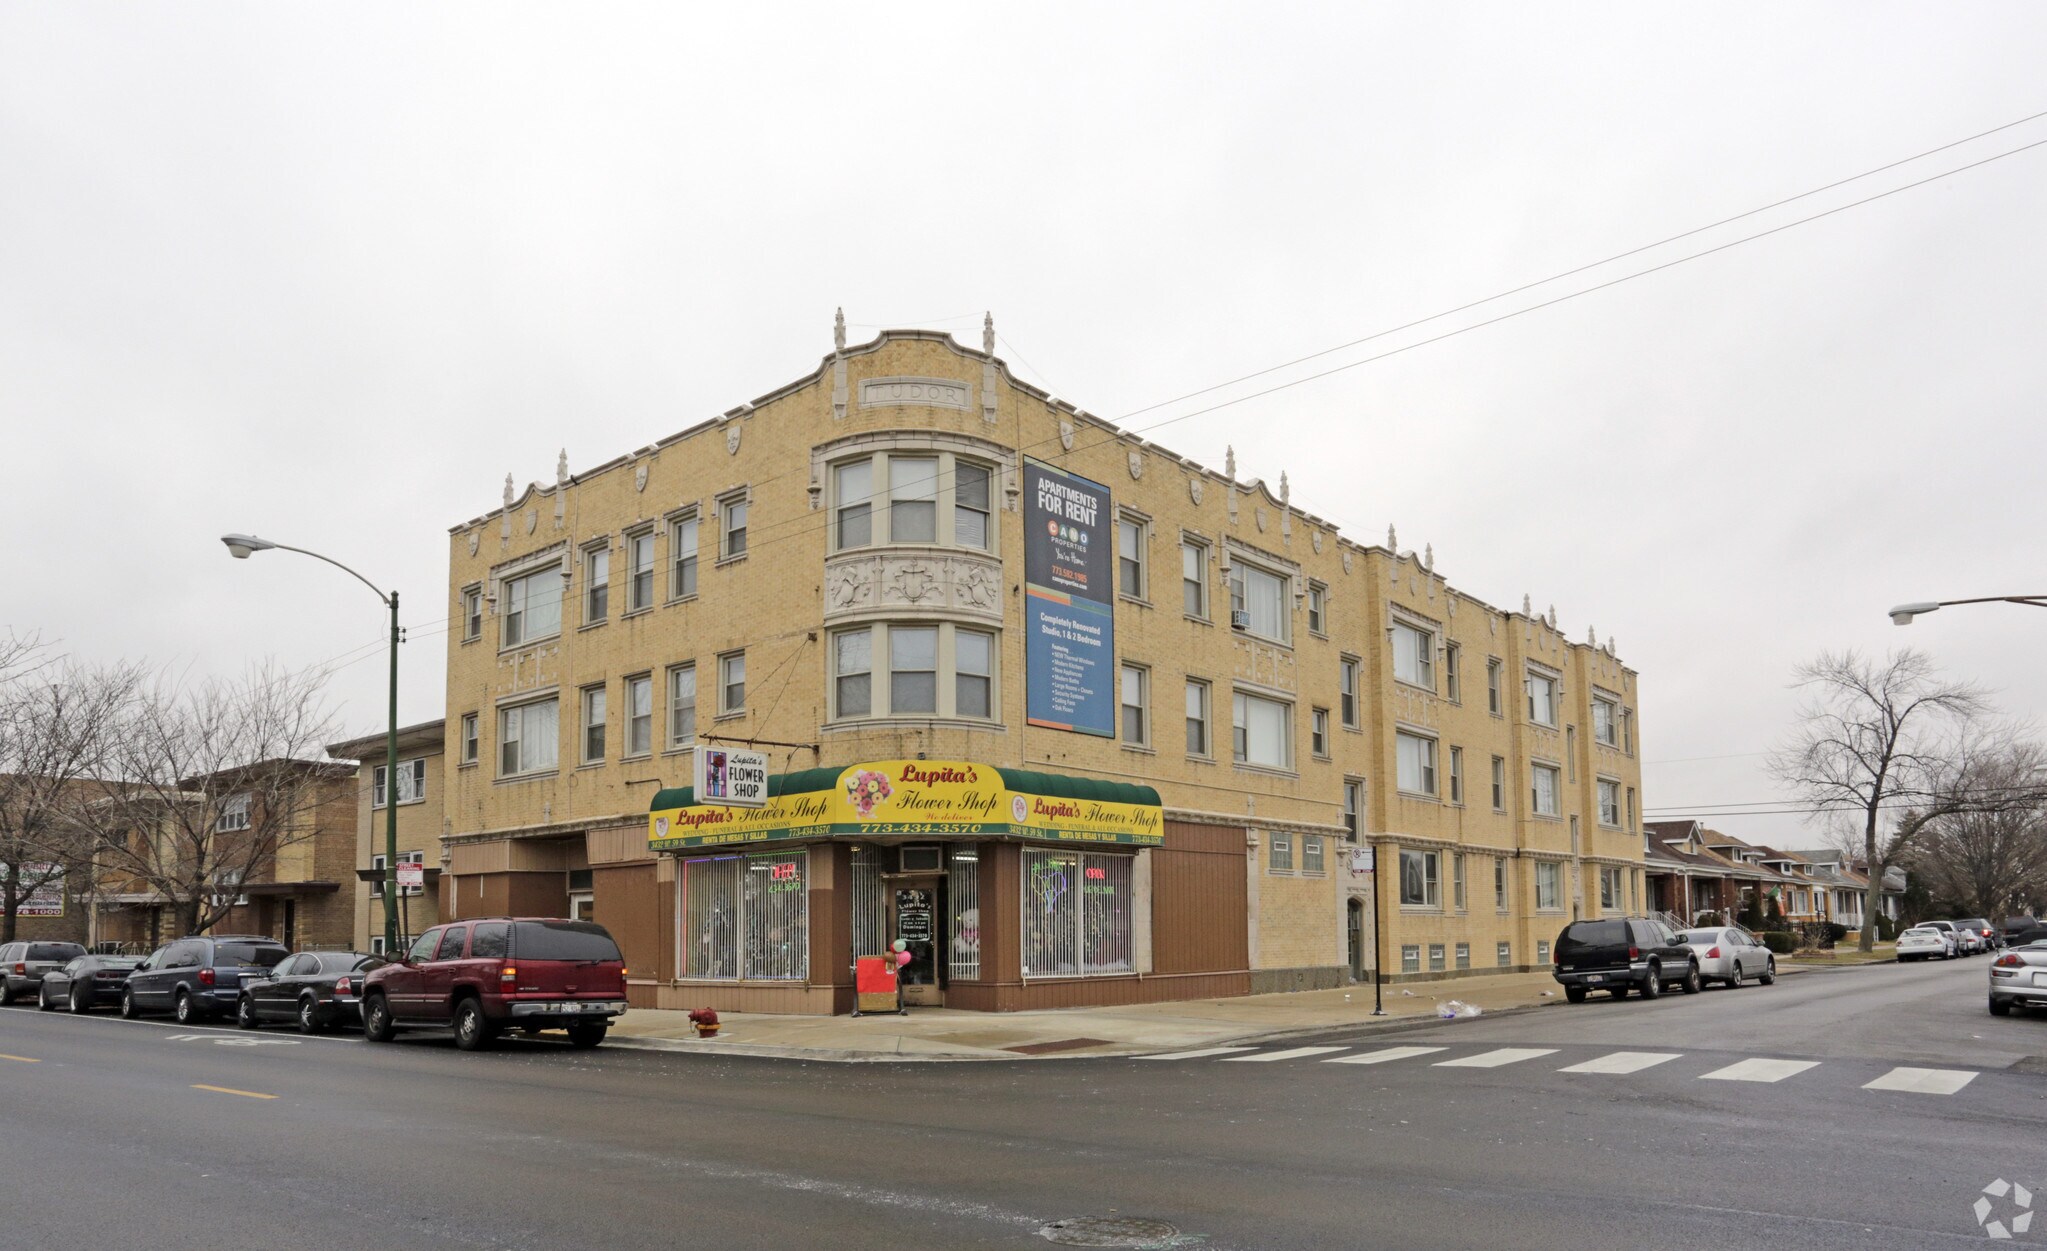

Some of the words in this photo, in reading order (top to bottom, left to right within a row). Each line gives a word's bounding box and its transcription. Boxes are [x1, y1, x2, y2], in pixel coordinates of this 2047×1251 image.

[871, 385, 958, 401] TUDOR
[1038, 477, 1097, 509] APARTMENTS
[1038, 490, 1062, 516] FOR
[1065, 500, 1097, 527] RENT
[1049, 520, 1088, 544] CANO
[1051, 536, 1087, 553] PROPERTIES
[1040, 612, 1071, 629] Completely
[1072, 620, 1101, 635] Renovated
[1041, 624, 1062, 638] Studio,
[1066, 631, 1072, 640] &
[1072, 632, 1077, 640] 2
[1077, 633, 1101, 647] Bedroom
[730, 754, 763, 766] Lupita's
[729, 766, 764, 784] FLOWER
[899, 764, 978, 788] Lupita's
[734, 783, 760, 798] SHOP
[896, 789, 952, 810] Flower
[957, 790, 998, 818] Shop
[676, 806, 734, 829] Lupita's
[739, 806, 785, 823] Flower
[790, 796, 828, 823] Shop
[925, 812, 940, 821] We
[941, 811, 974, 821] deliver
[1033, 797, 1081, 821] Lupita's
[1084, 803, 1126, 823] Flower
[1130, 807, 1158, 833] Shop
[683, 829, 710, 837] WEDDING
[713, 826, 738, 834] FUNERAL
[745, 823, 757, 831] ALL
[757, 821, 791, 832] OCCASIONS
[788, 825, 831, 837] 773-434-3570
[860, 823, 982, 833] 773-434-3570
[1008, 825, 1022, 835] 3432
[1038, 821, 1065, 830] WEDDING
[1068, 823, 1091, 831] FUNERAL
[1107, 825, 1134, 834] OCCASIONS
[702, 835, 718, 845] RENTA
[719, 834, 727, 843] DE
[727, 833, 745, 842] MESAS
[744, 832, 749, 840] Y
[749, 831, 767, 840] SILLAS
[1058, 830, 1074, 840] RENTA
[1075, 831, 1082, 840] DE
[1082, 832, 1098, 841] MESAS
[1097, 832, 1102, 840] Y
[1102, 833, 1117, 842] SILLAS
[651, 840, 664, 849] 3432
[1085, 867, 1105, 879] OPEN
